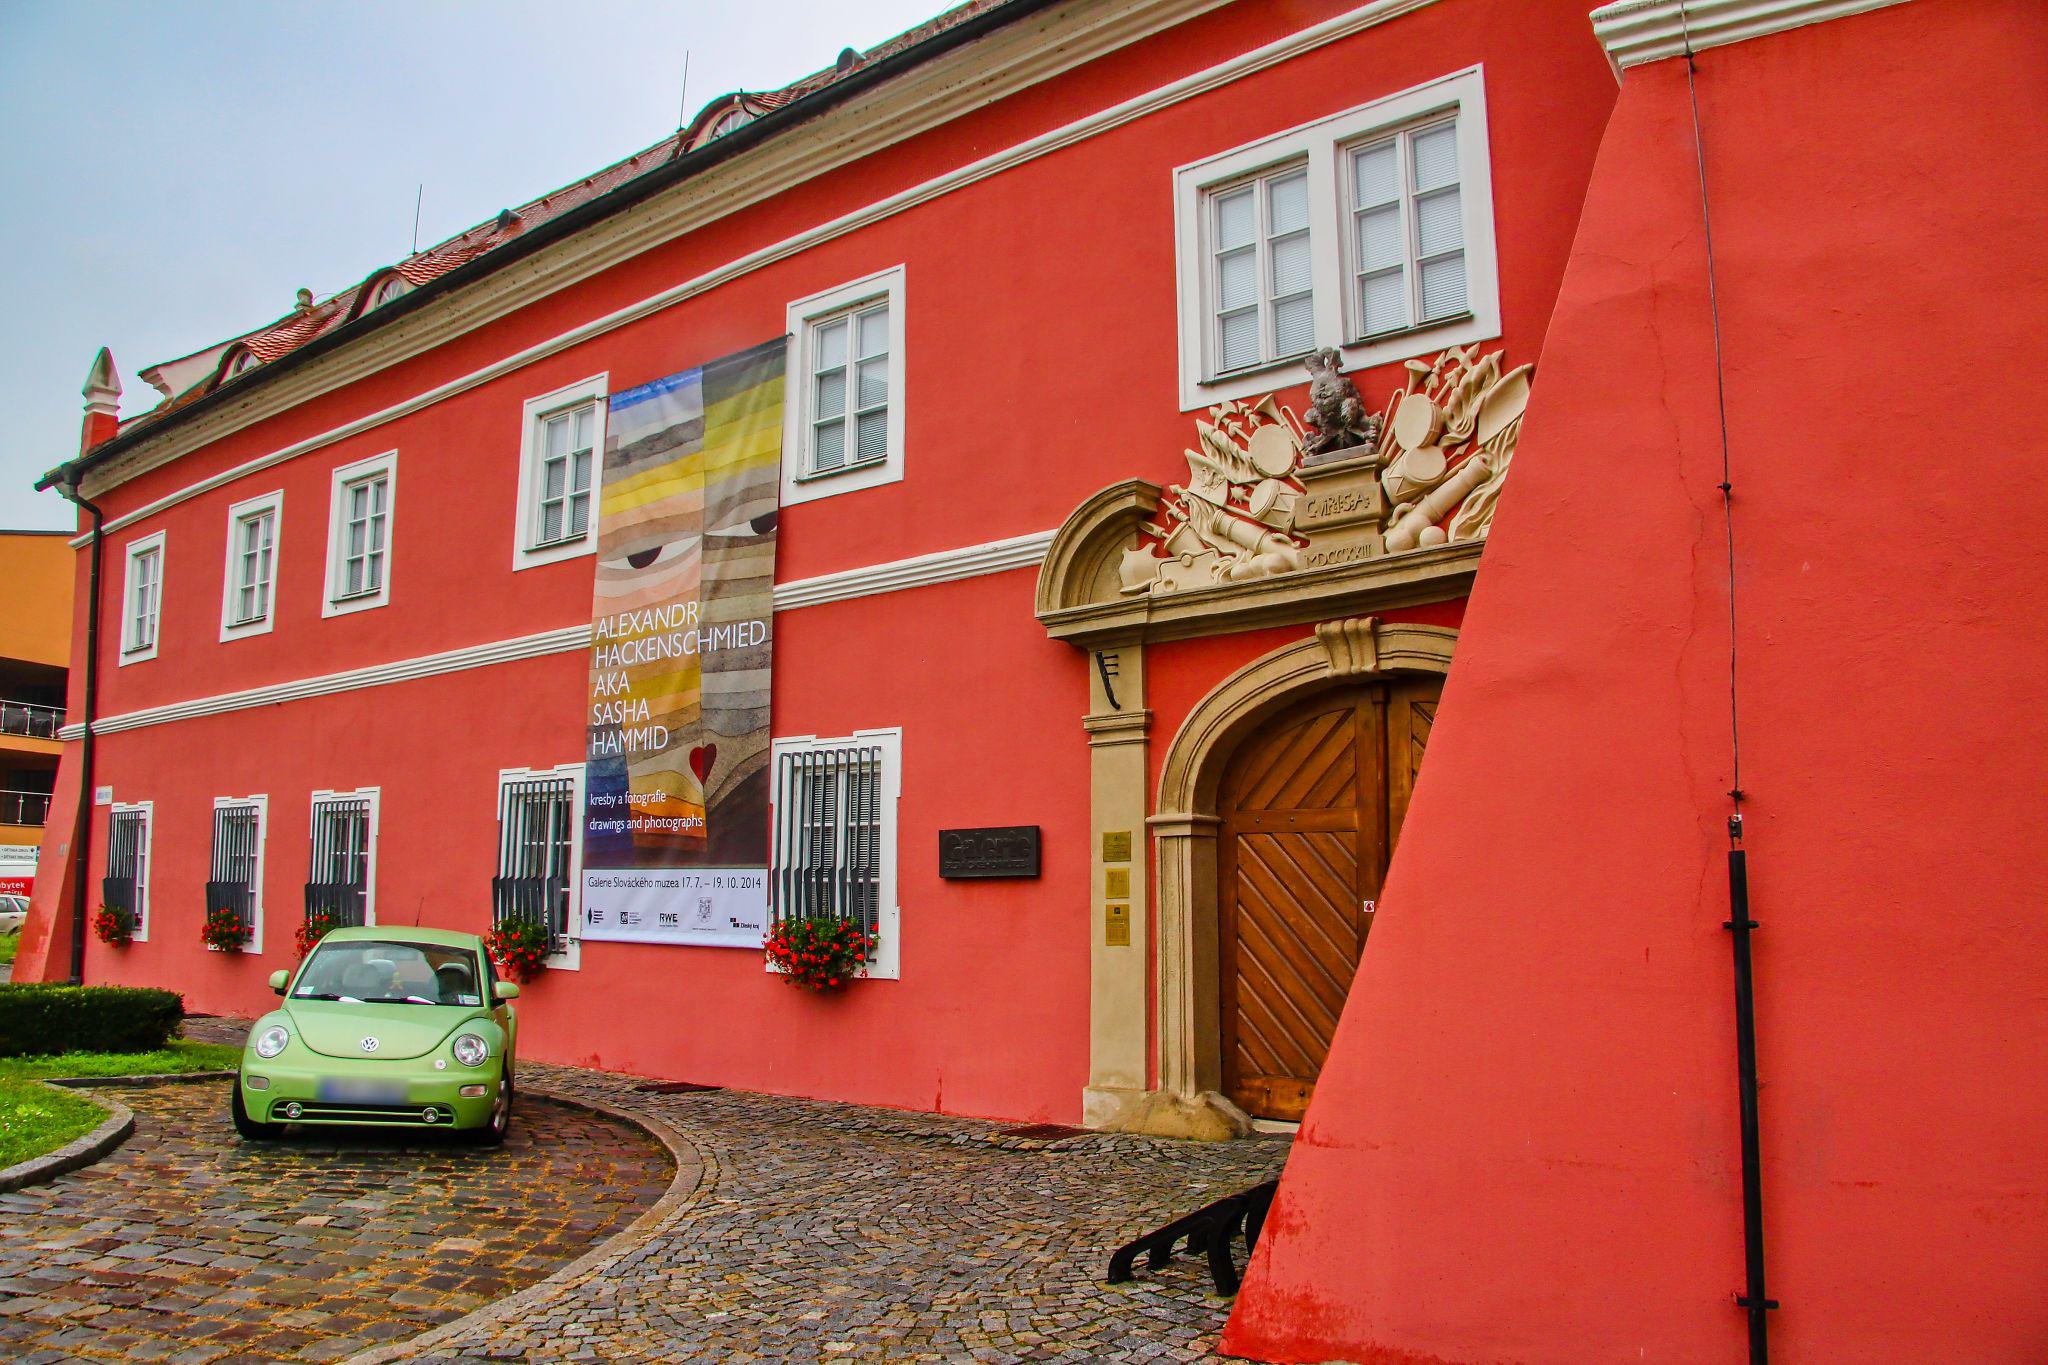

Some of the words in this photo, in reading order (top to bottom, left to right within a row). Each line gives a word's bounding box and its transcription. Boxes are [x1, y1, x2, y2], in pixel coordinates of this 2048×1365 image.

[595, 600, 699, 640] ALEXANDR
[595, 620, 766, 669] HACKENSCHMIED
[593, 671, 630, 697] AKA
[593, 698, 650, 727] SASHA
[592, 726, 669, 755] HAMMID
[590, 792, 616, 808] kresby
[618, 795, 623, 805] a
[625, 789, 667, 807] fotografie
[589, 817, 625, 833] drawings
[626, 815, 643, 829] and
[644, 813, 703, 832] photographs
[0, 881, 26, 890] bytek
[588, 876, 612, 888] Galerie
[613, 876, 654, 888] Slováckého
[654, 879, 680, 888] muzea
[741, 876, 761, 889] 2014
[659, 912, 678, 923] RWE
